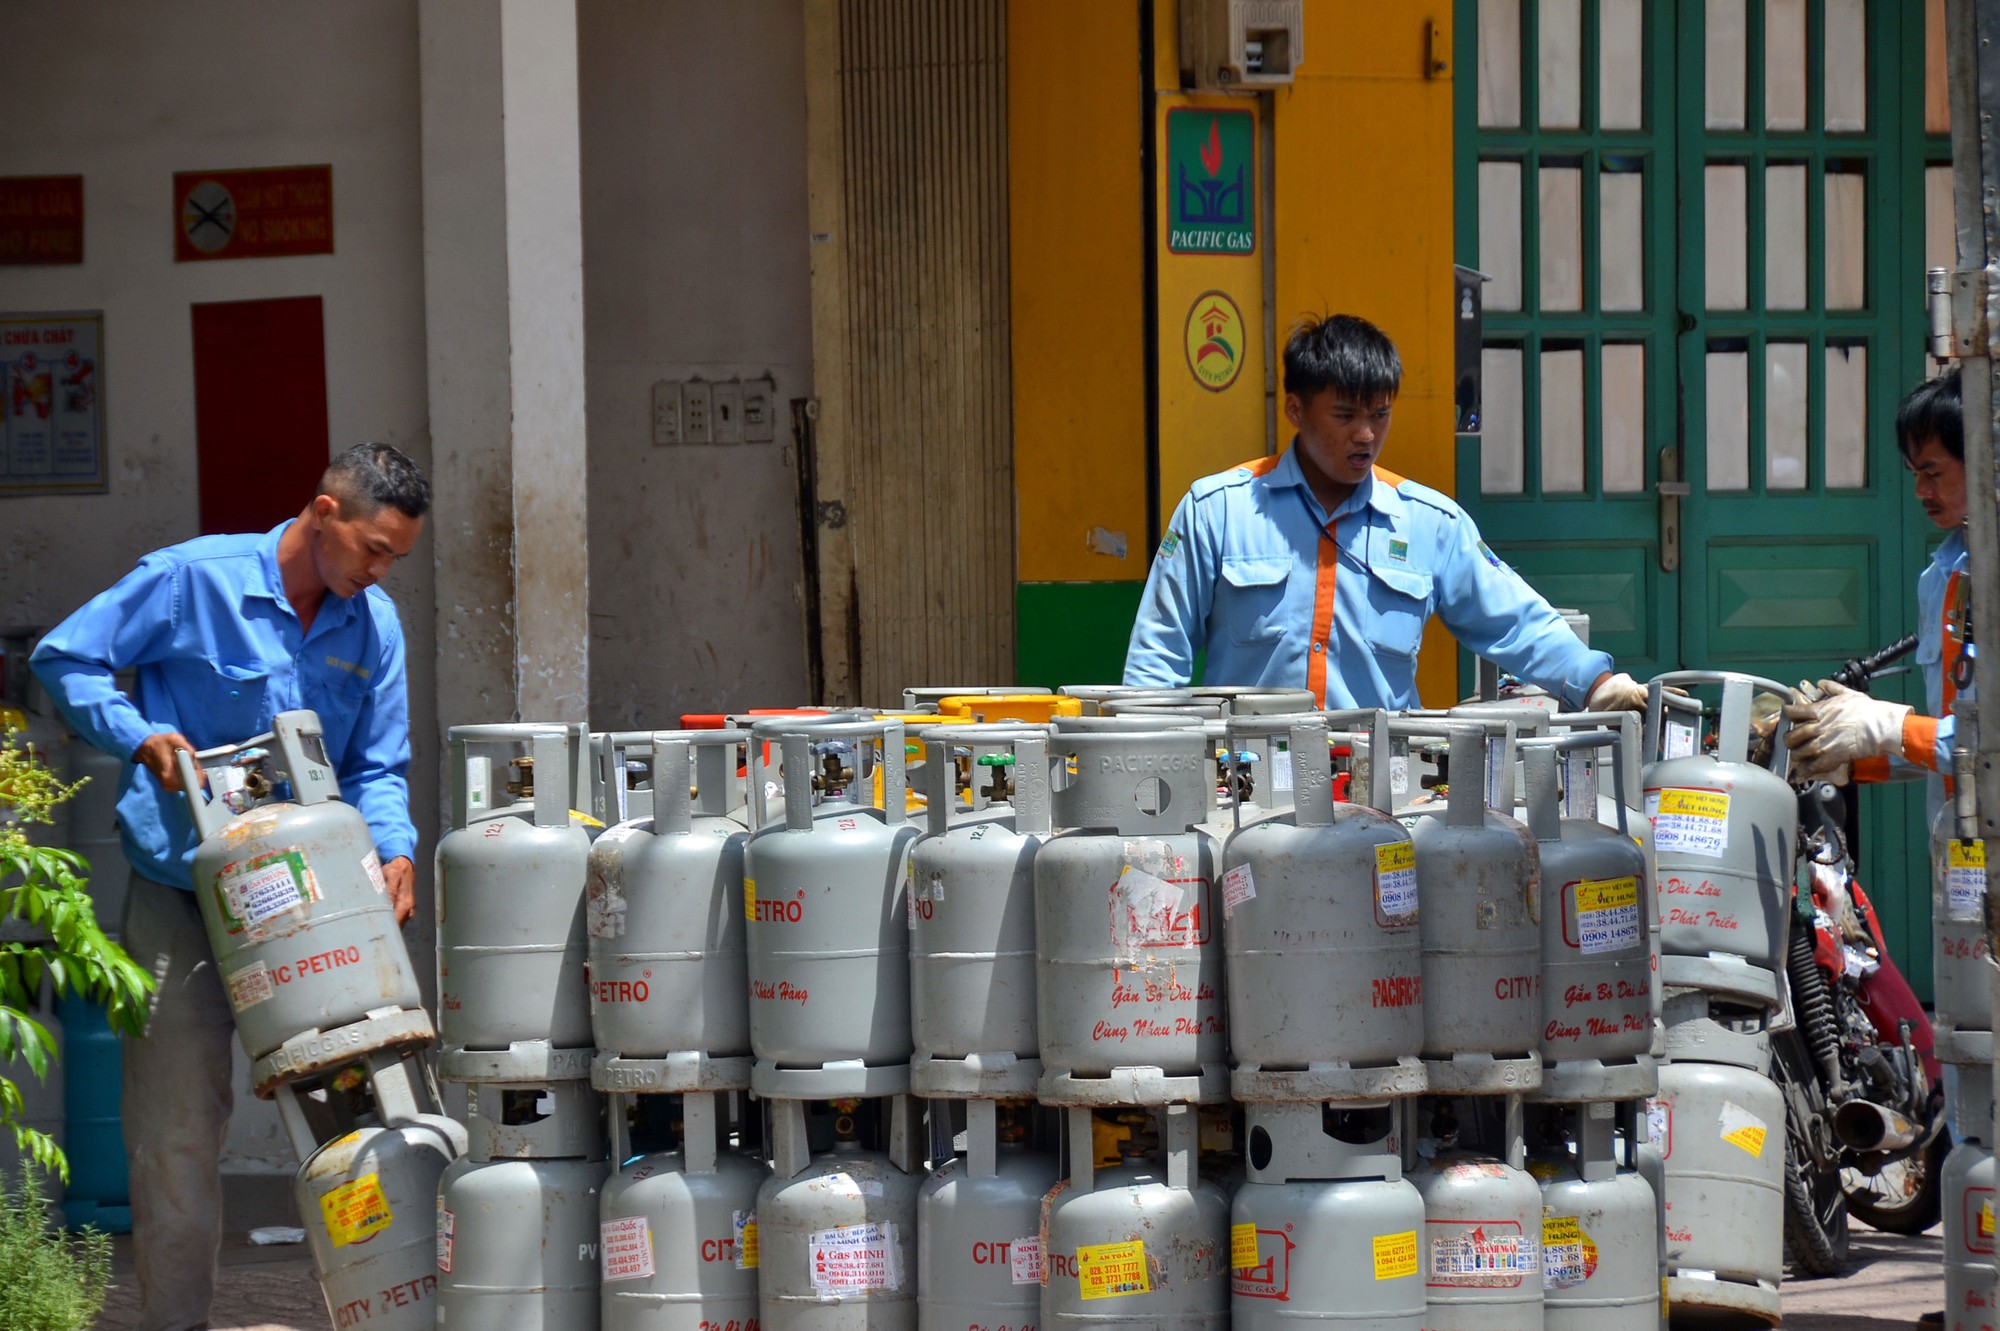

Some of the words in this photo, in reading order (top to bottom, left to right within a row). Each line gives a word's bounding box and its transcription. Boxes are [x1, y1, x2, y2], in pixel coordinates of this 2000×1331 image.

[240, 218, 259, 243] NO
[262, 214, 327, 242] SMOKING
[1170, 230, 1224, 248] PACIFIC
[1226, 231, 1253, 249] GAS
[1198, 364, 1213, 381] CITY
[308, 769, 325, 782] 13.1
[1296, 751, 1308, 787] PACIFIC
[1655, 832, 1680, 841] 0908
[1683, 834, 1721, 847] 148676
[1668, 877, 1692, 895] Dài
[1694, 880, 1722, 897] Lâu
[1382, 892, 1402, 903] 0908
[756, 899, 802, 922] ETRO
[1595, 904, 1637, 918] 38.44.88.67
[1668, 908, 1700, 926] Phát
[1596, 914, 1638, 928] 38.44.71.68
[1581, 931, 1608, 943] 0908
[1610, 925, 1639, 939] 148676
[296, 946, 360, 978] PETRO
[778, 981, 809, 1007] Hàng
[1111, 984, 1140, 1009] Gắn
[1168, 983, 1192, 1001] Dài
[1371, 975, 1412, 1008] PACIFIC
[1494, 976, 1532, 1001] CITY
[1564, 984, 1593, 1009] Gắn
[1596, 982, 1614, 1002] Bó
[1618, 980, 1636, 999] Dài
[1092, 1020, 1129, 1043] Cùng
[1545, 1019, 1582, 1042] Cùng
[1586, 1017, 1620, 1038] Nhau
[467, 1088, 479, 1119] 13.7
[578, 1243, 598, 1262] PV
[702, 1238, 735, 1262] CIT
[828, 1250, 850, 1260] Gas
[853, 1249, 885, 1260] MINH
[972, 1241, 1012, 1265] CIT
[1017, 1245, 1038, 1253] MINH
[1543, 1244, 1578, 1255] 4.88.67
[1543, 1252, 1580, 1264] 4.71.68
[1047, 1252, 1080, 1279] TRO
[1104, 1264, 1121, 1274] 3731
[1121, 1261, 1139, 1272] 7777
[1545, 1264, 1581, 1277] 48676
[1105, 1273, 1122, 1284] 3731
[377, 1274, 438, 1314] PETR
[1255, 1284, 1277, 1294] GAS
[337, 1298, 371, 1329] CITY
